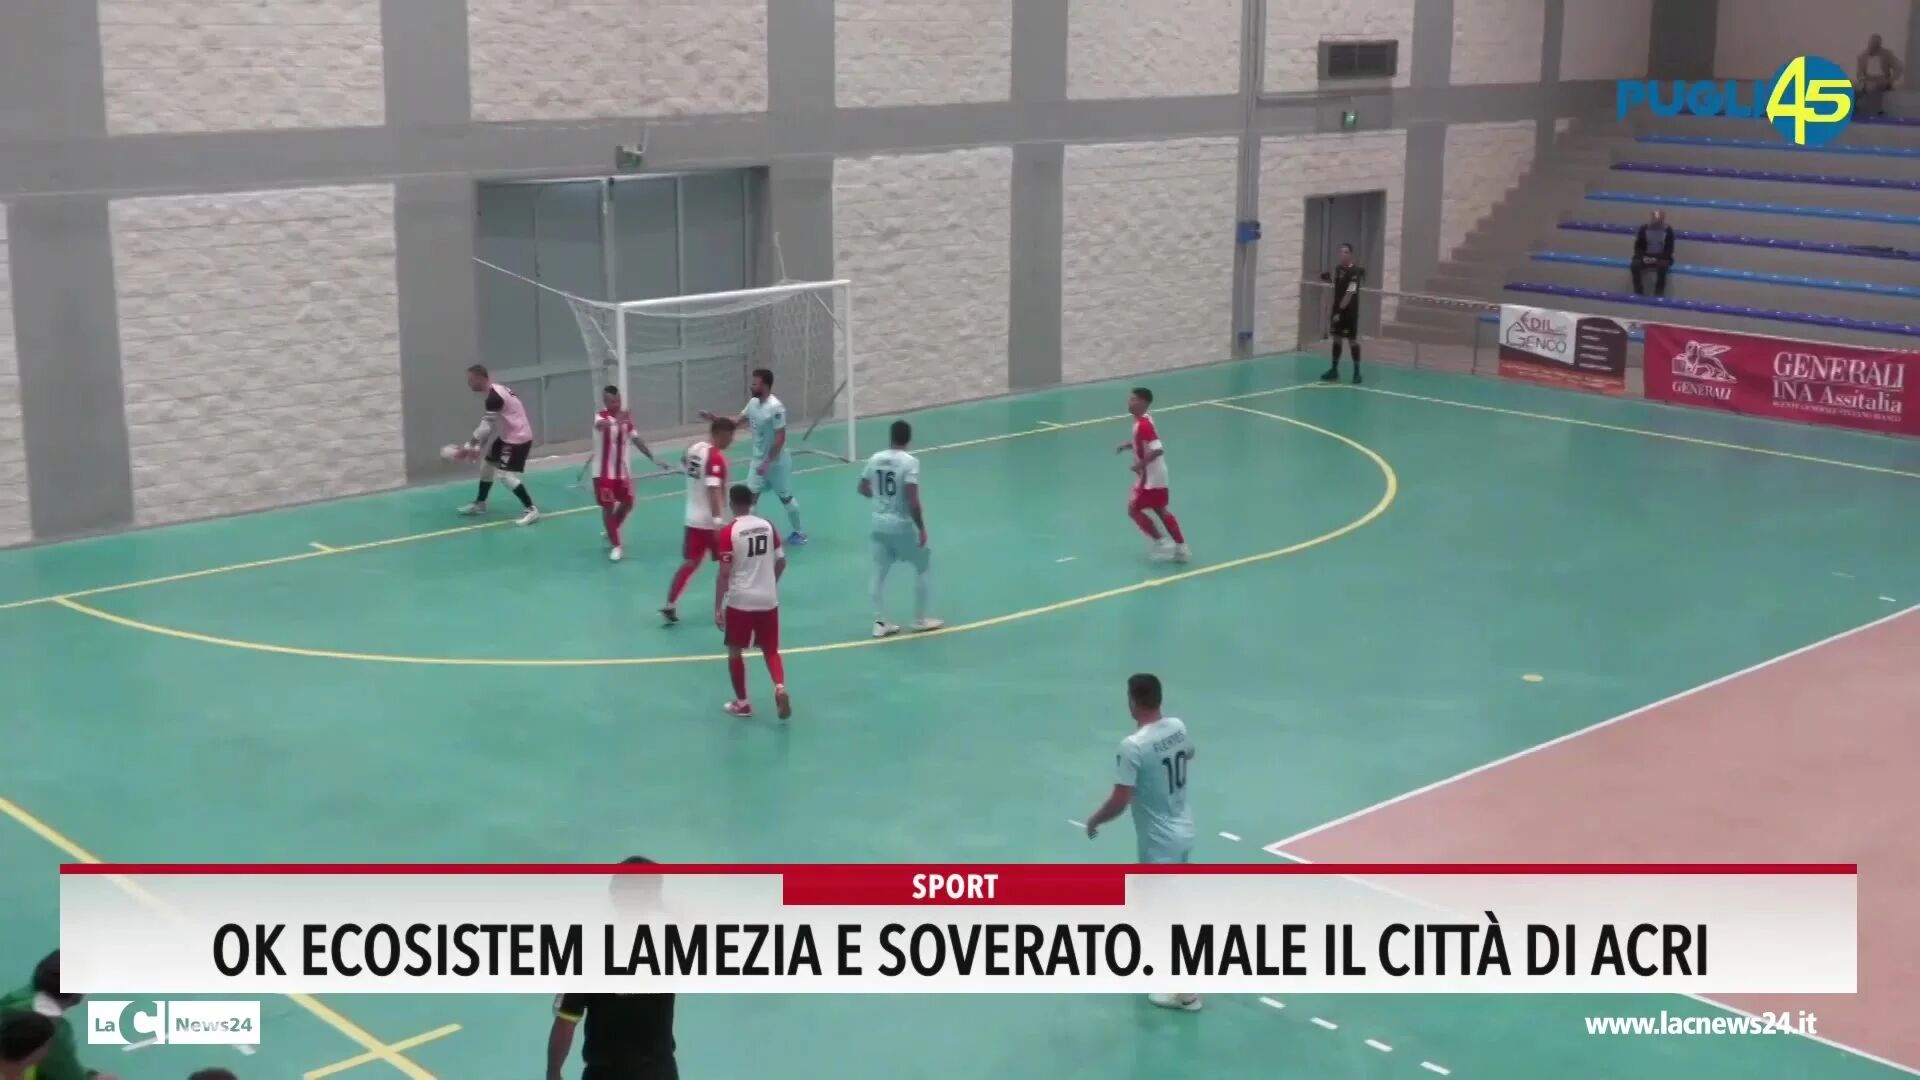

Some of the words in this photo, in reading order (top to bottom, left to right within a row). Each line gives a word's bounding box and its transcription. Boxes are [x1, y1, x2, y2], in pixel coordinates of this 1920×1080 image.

[1773, 351, 1905, 388] GENERALI
[1671, 381, 1732, 400] GENERALI
[1773, 380, 1813, 402] INA
[1819, 385, 1903, 414] Assitalia
[875, 469, 897, 496] 16
[747, 534, 768, 558] 10
[1162, 750, 1188, 795] 10
